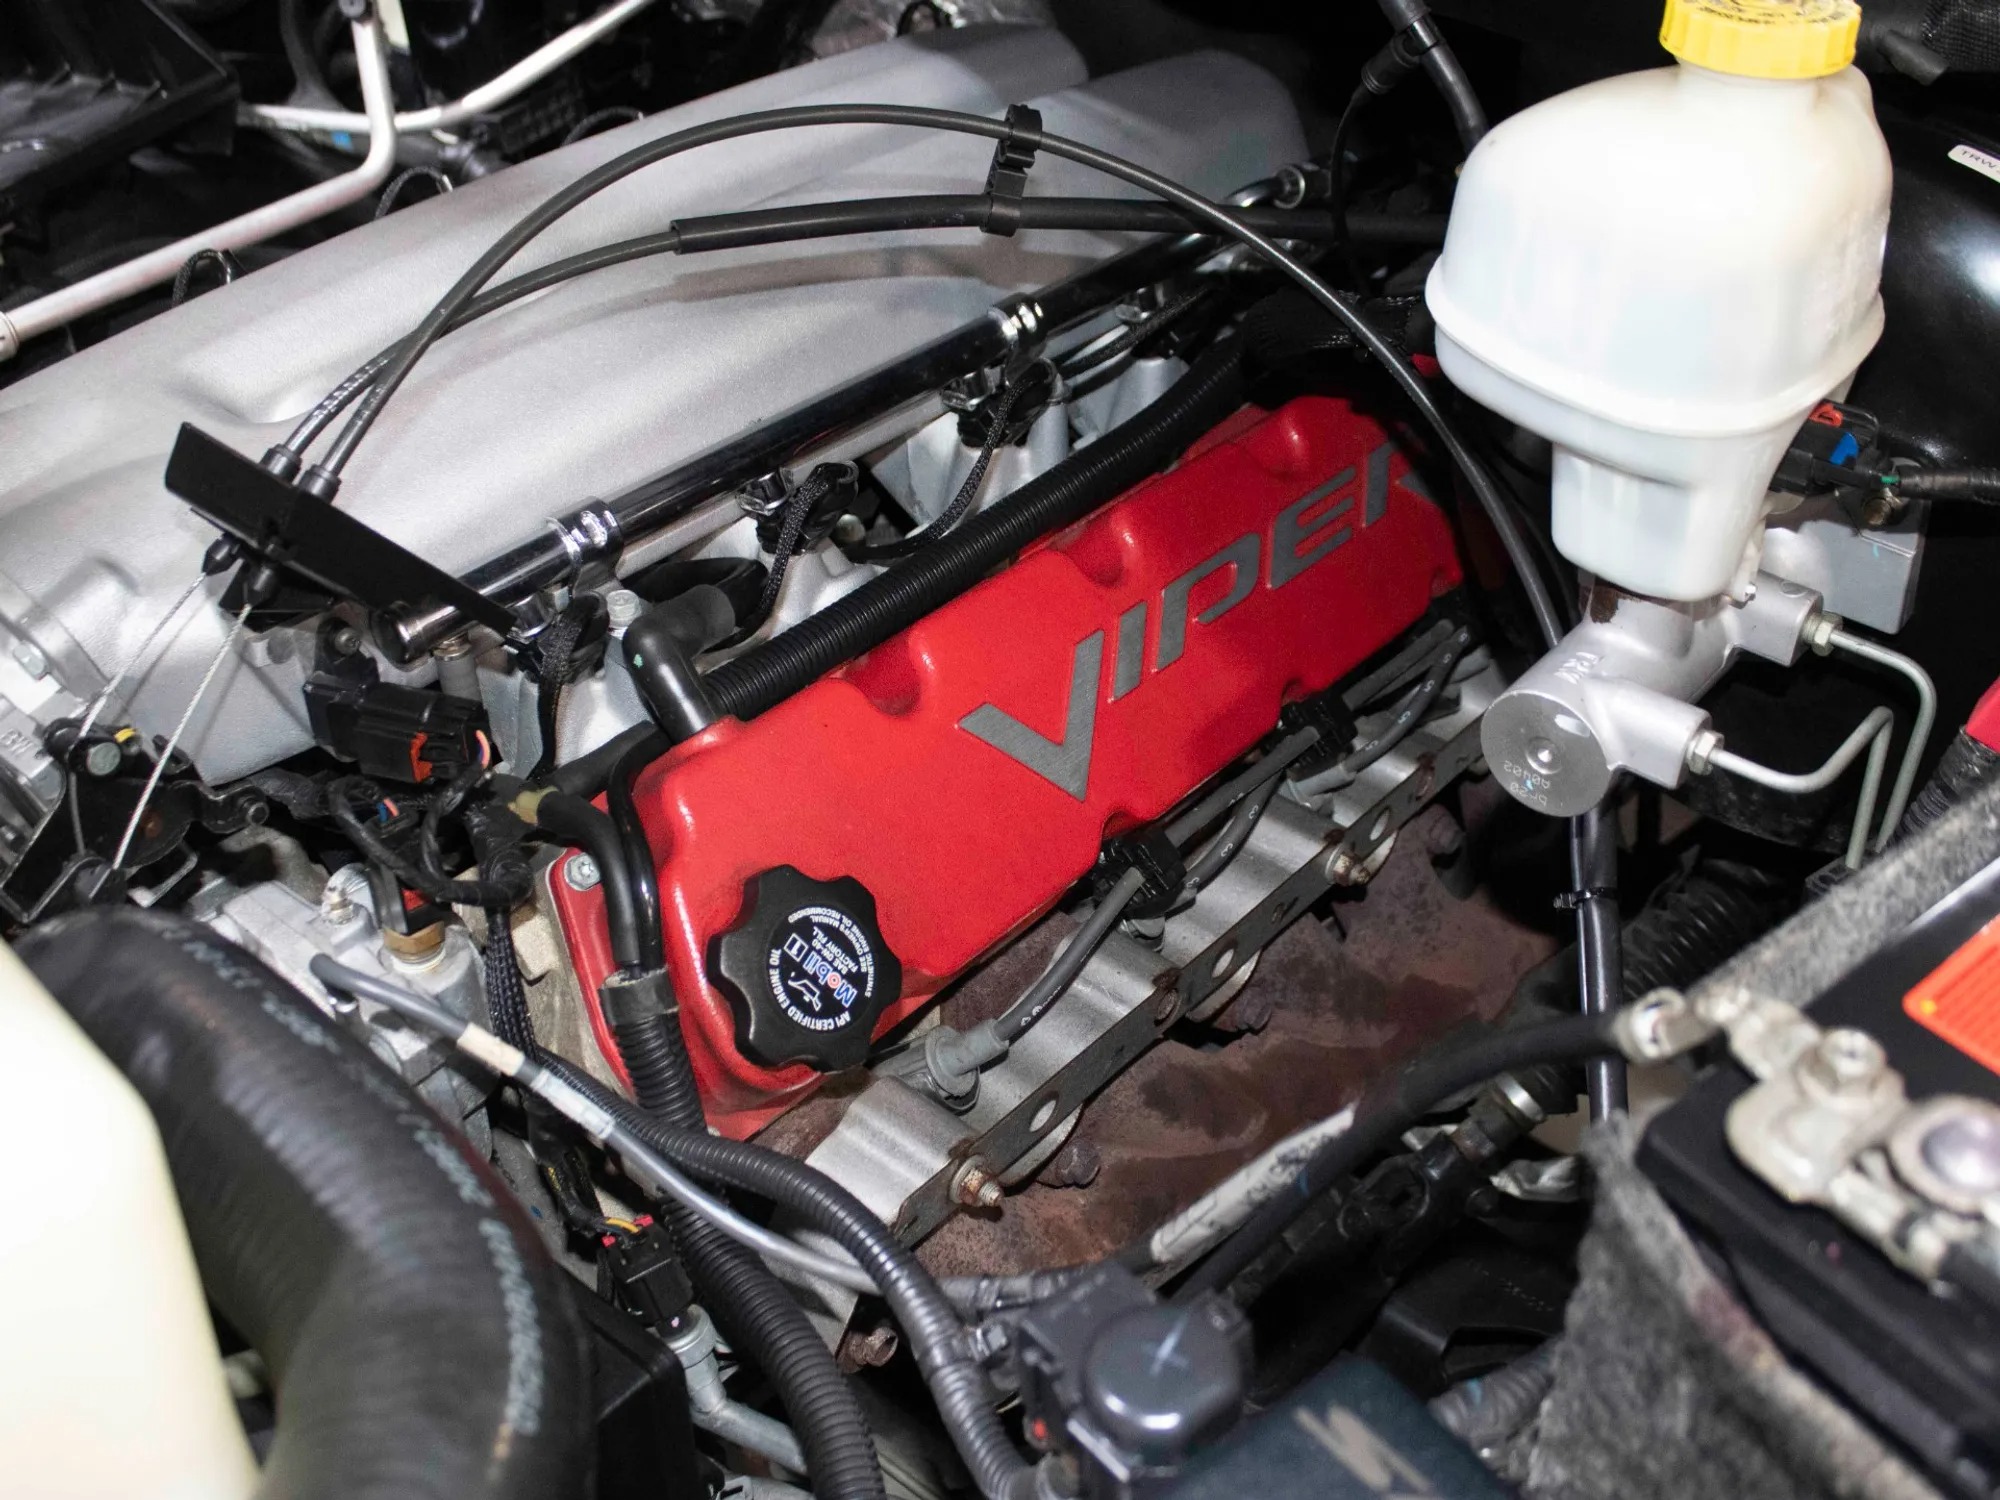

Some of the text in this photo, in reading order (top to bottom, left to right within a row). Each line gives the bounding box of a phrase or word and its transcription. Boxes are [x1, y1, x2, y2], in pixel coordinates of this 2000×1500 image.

[1248, 804, 1259, 819] 3
[1220, 843, 1233, 857] 3
[809, 913, 840, 928] MANUAL
[812, 925, 858, 972] FACTORY FILL
[849, 923, 869, 953] ENGINE
[832, 957, 848, 975] SAE
[768, 948, 850, 1030] API CERTIFIED ENGINE OIL
[802, 949, 858, 1008] Mobil
